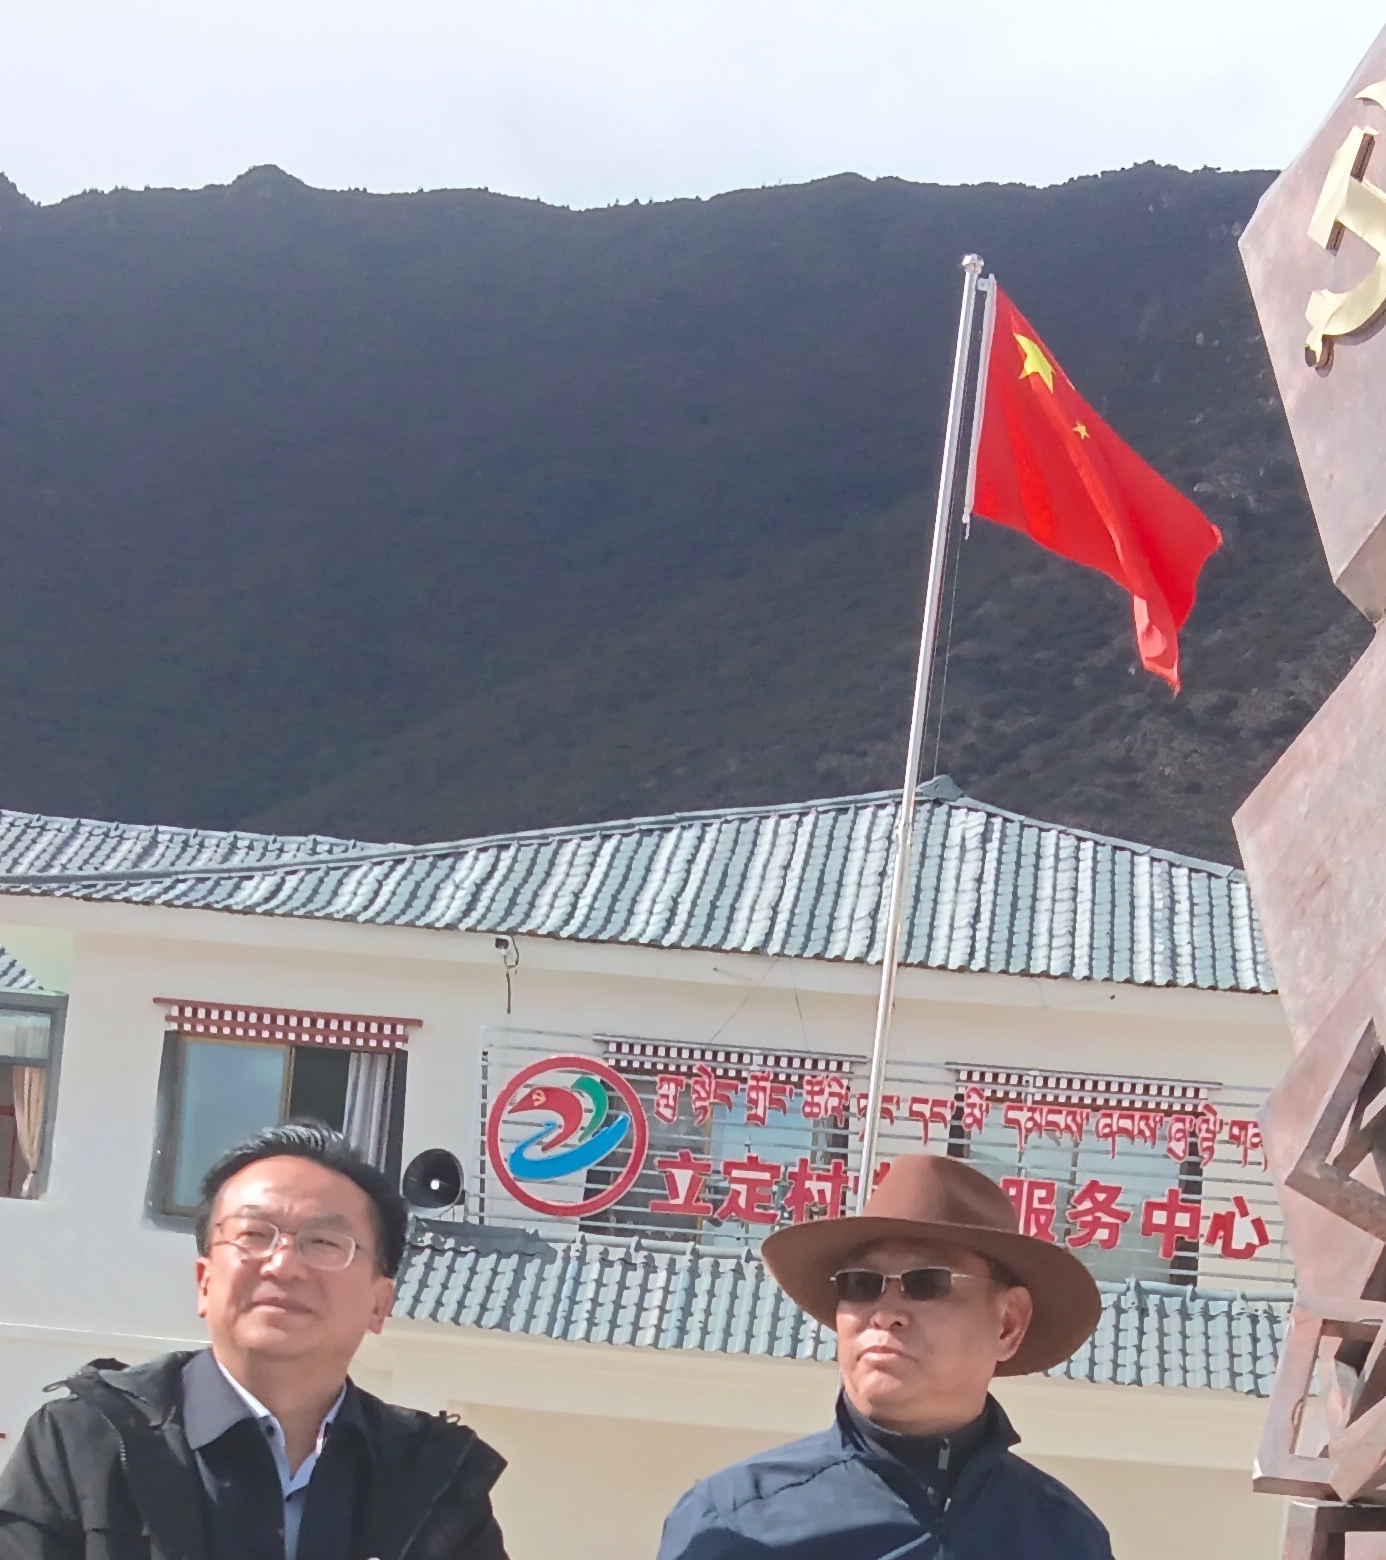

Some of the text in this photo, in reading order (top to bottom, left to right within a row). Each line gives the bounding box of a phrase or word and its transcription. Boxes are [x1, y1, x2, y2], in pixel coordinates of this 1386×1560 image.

[649, 1149, 1270, 1260] 立定村服务中心
